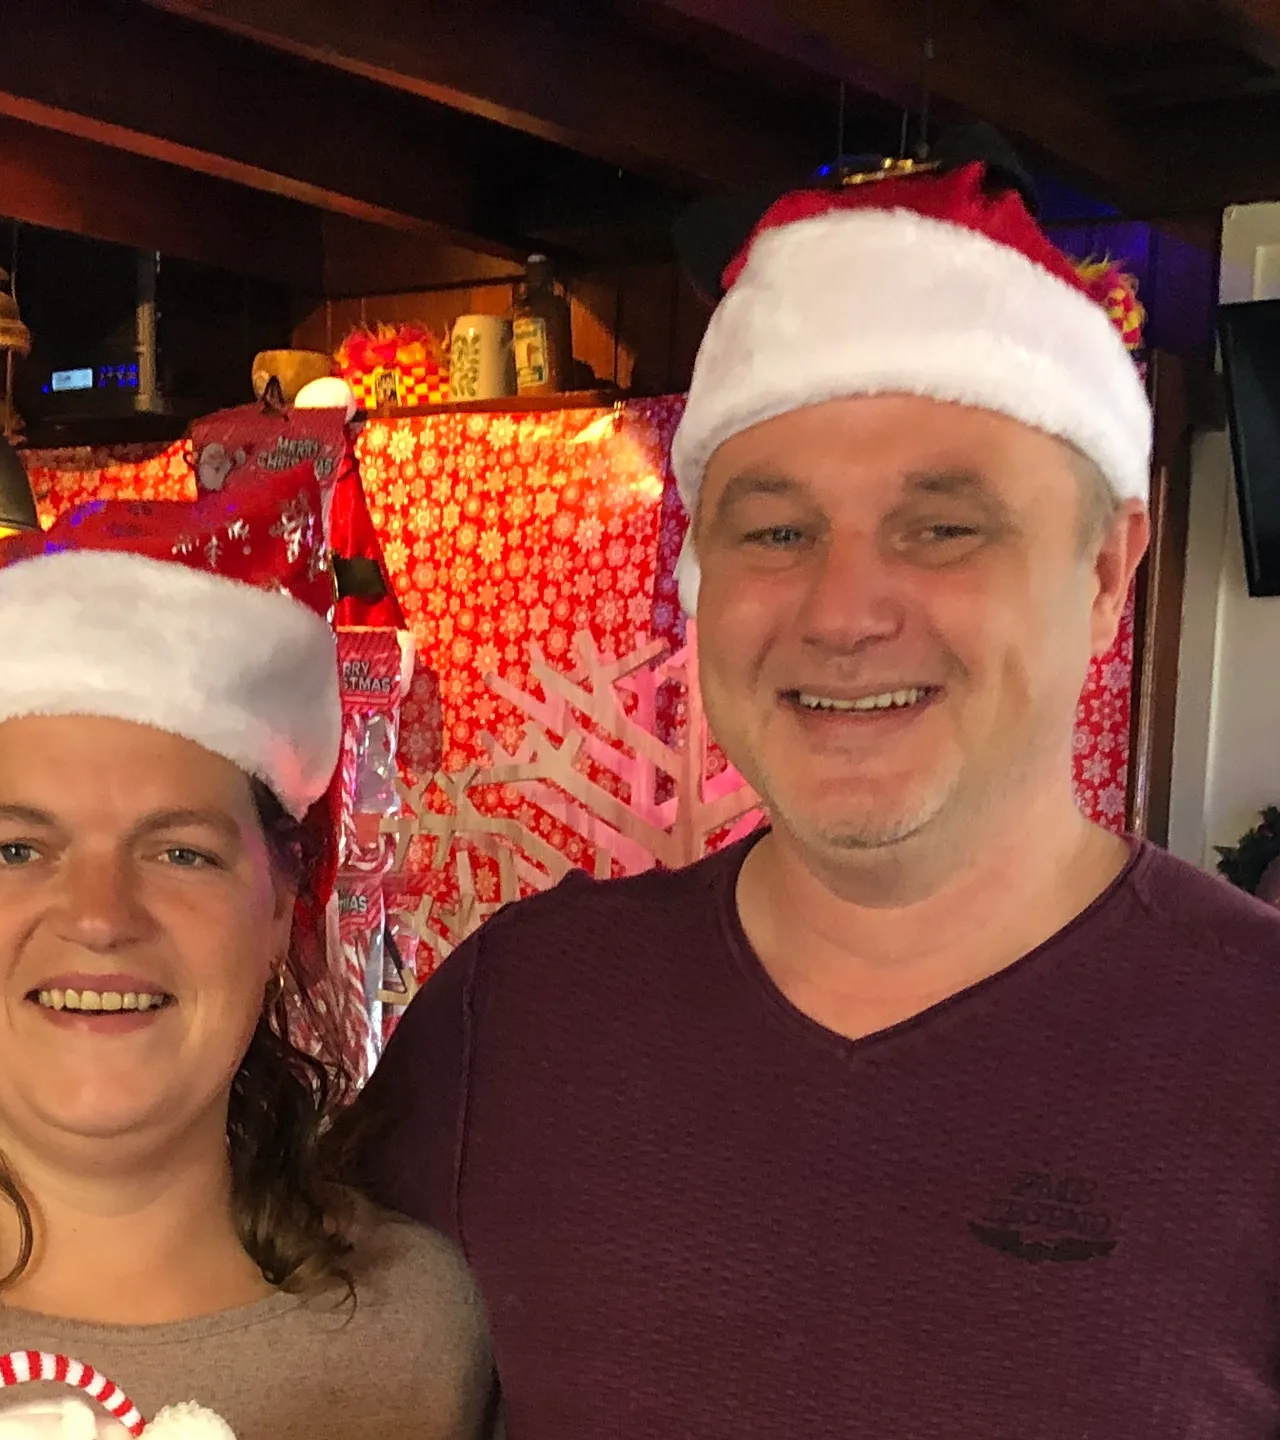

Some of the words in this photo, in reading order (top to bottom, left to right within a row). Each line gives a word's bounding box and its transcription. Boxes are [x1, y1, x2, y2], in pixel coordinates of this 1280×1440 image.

[257, 452, 334, 477] CHRISAS
[342, 661, 370, 677] RRY
[343, 677, 391, 693] STMAS
